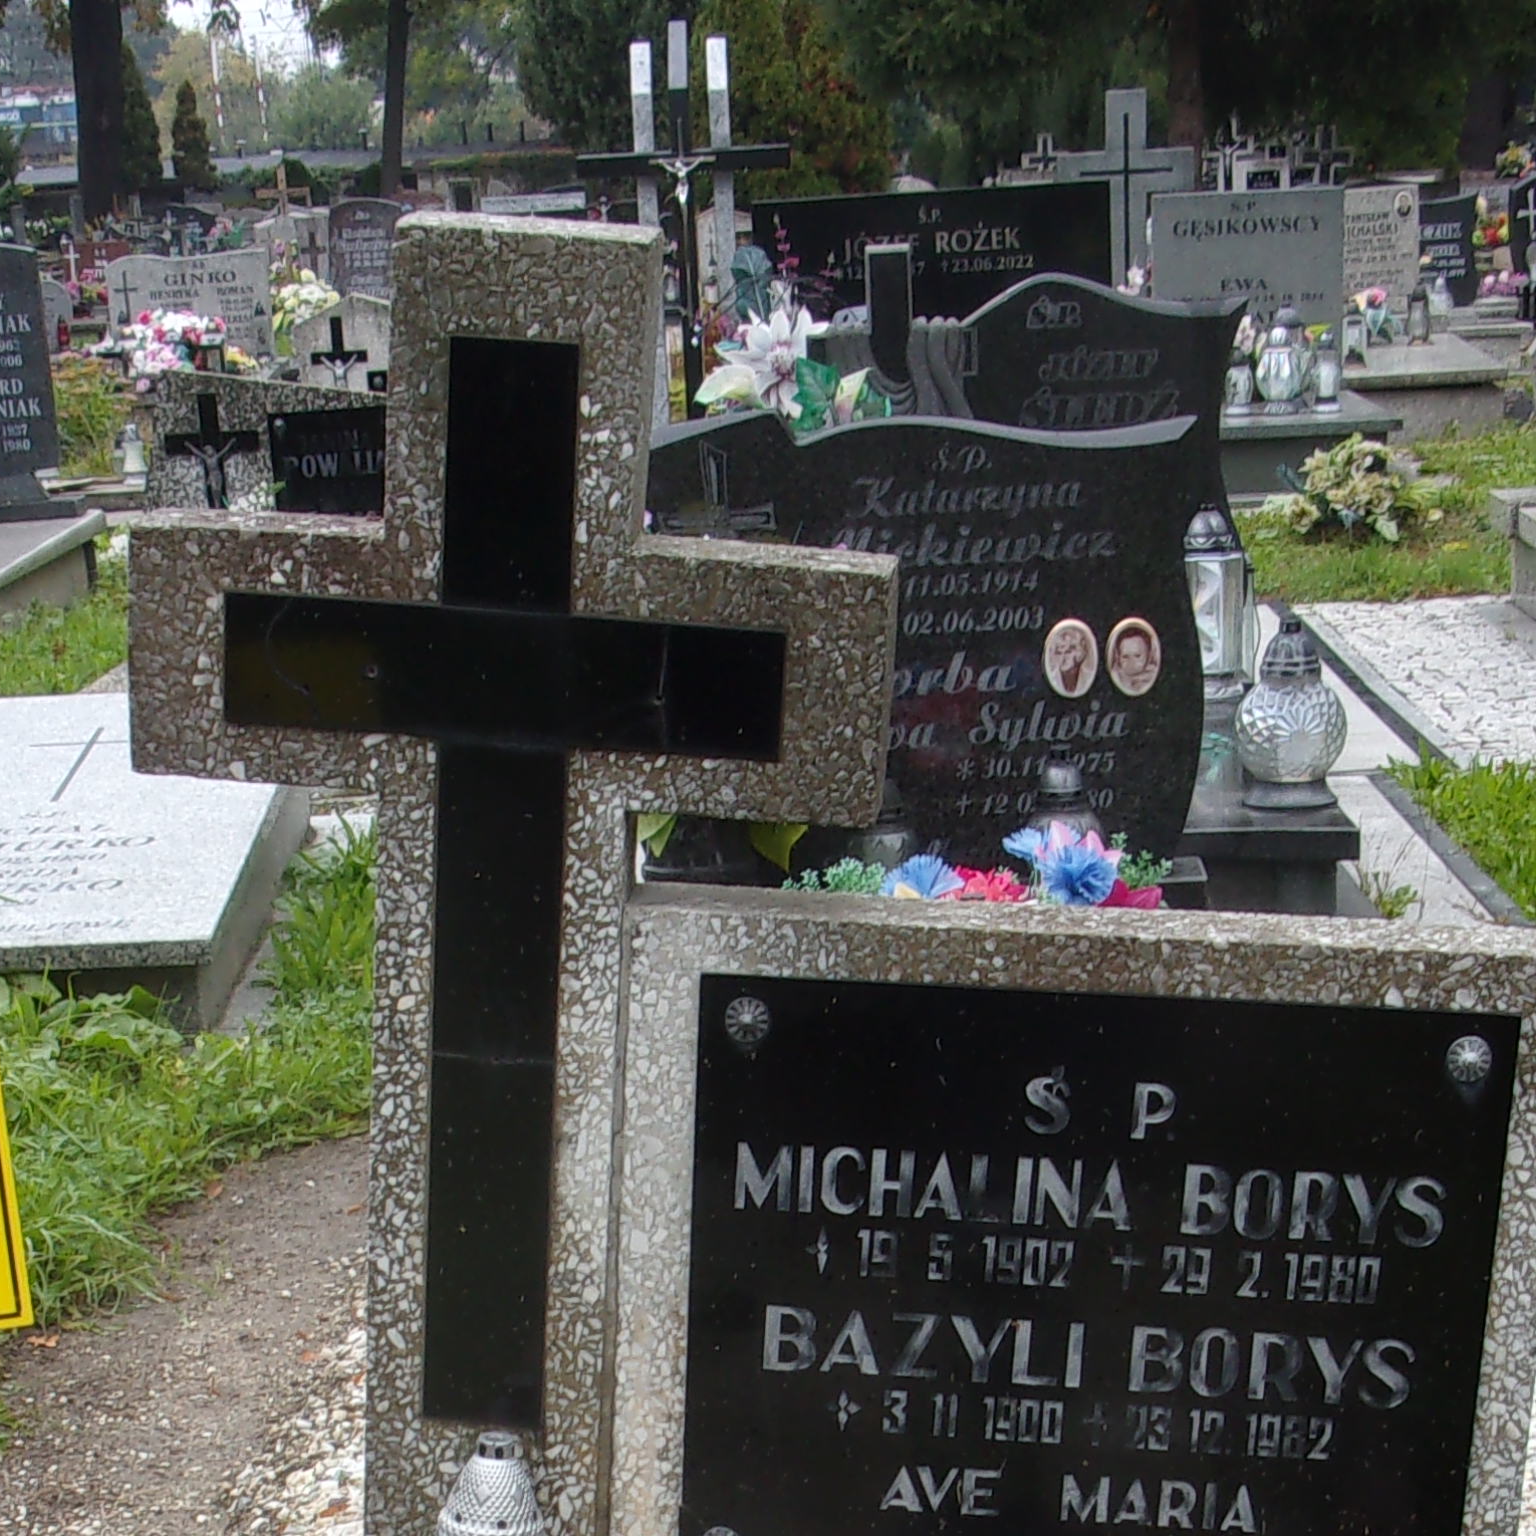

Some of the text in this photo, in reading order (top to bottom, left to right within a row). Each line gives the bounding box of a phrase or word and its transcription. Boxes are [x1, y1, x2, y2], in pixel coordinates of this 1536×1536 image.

[935, 221, 1021, 253] ROŻEK
[1173, 216, 1320, 241] GĘSIKOWSCY
[164, 271, 236, 286] GINKO
[845, 476, 1082, 519] Katarzyna
[902, 606, 1044, 635] 02.06.2003
[969, 701, 1129, 750] Sylwia
[734, 1141, 1447, 1249] MICHALINA BORYS
[857, 1228, 898, 1278] 19
[928, 1233, 953, 1282] 5
[982, 1234, 1075, 1288] 1902
[1161, 1245, 1213, 1296] 29
[1284, 1252, 1381, 1304] 1980
[763, 1304, 1415, 1410] BAZYLI BORYS
[882, 1389, 908, 1434] 3
[983, 1395, 1064, 1444] 1900
[879, 1463, 1257, 1533] AVE MARIA
